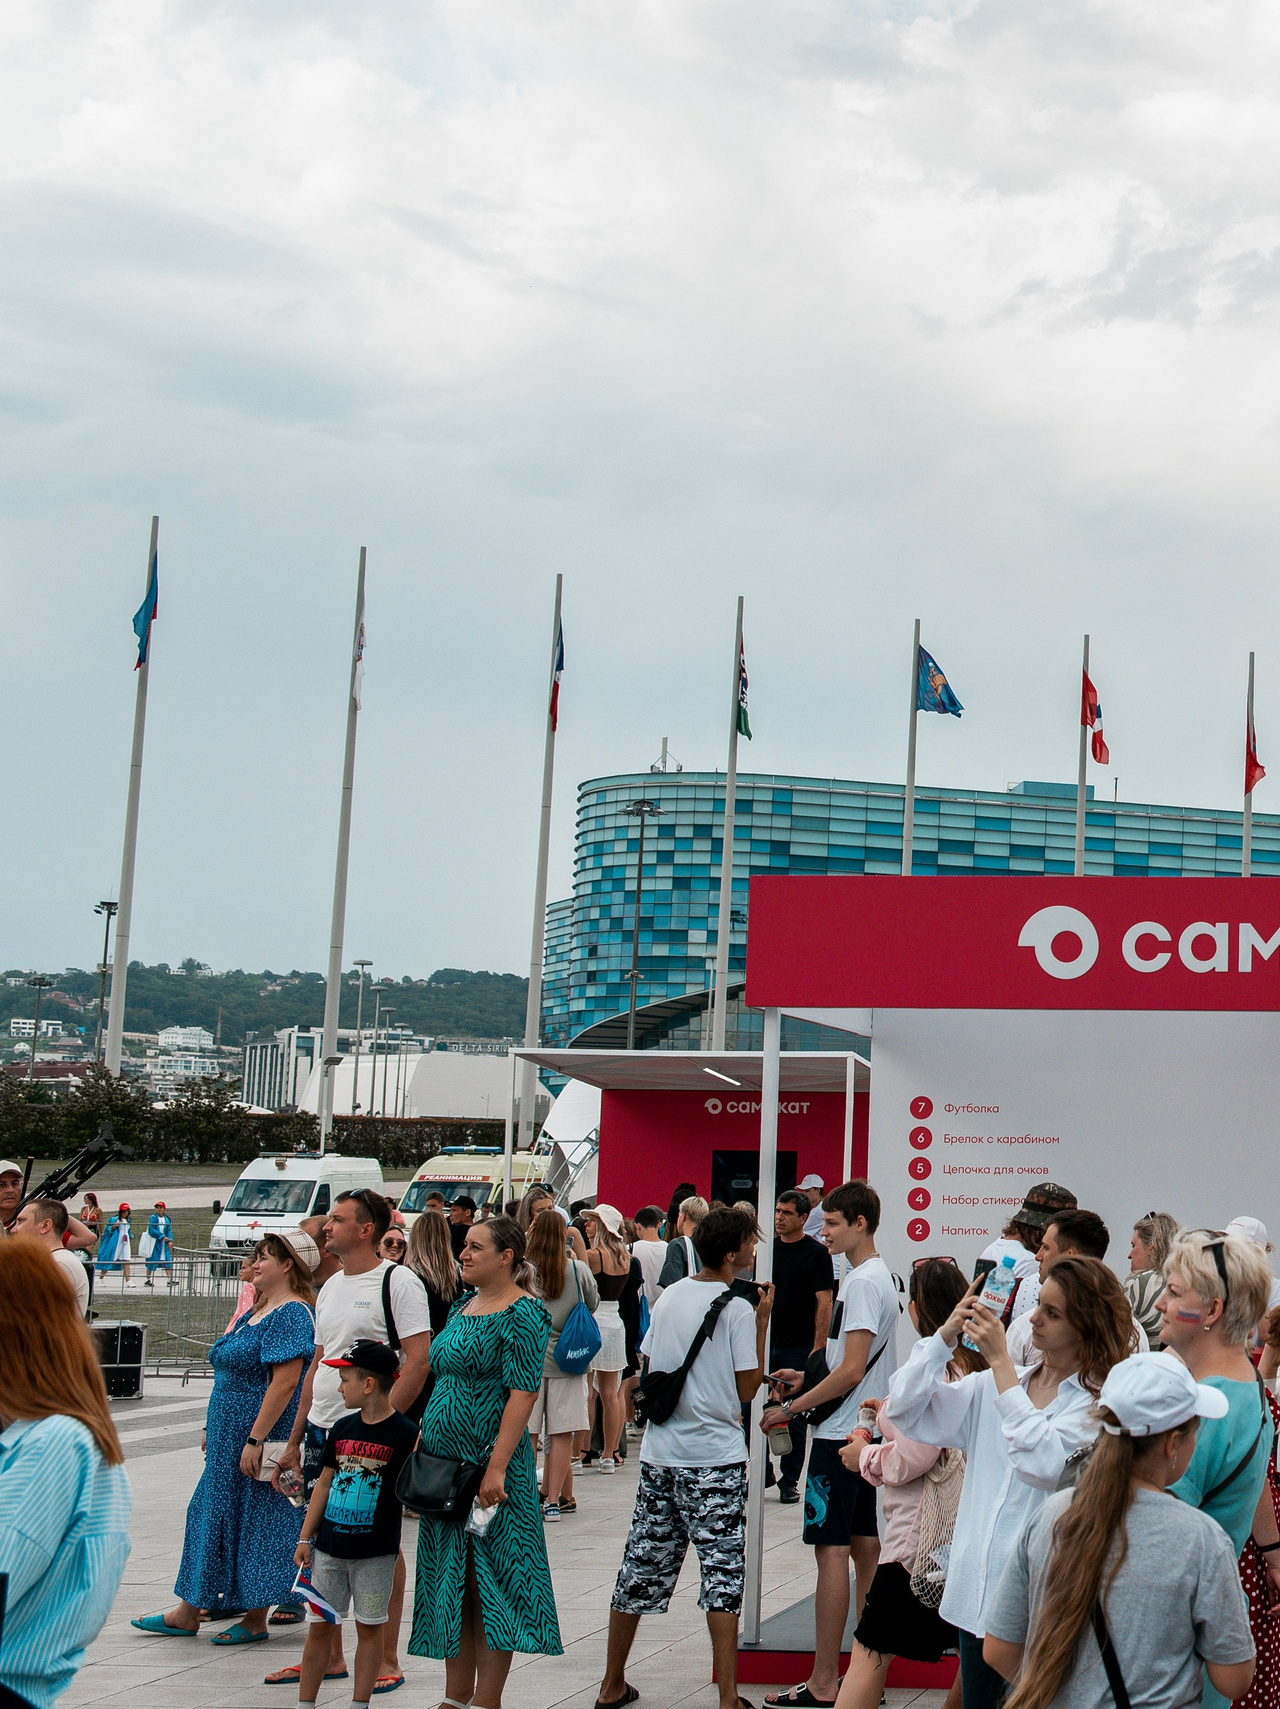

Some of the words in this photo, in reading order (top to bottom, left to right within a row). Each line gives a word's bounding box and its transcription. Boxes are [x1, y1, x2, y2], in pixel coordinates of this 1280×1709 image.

[452, 1044, 483, 1052] DELTA
[487, 1044, 510, 1053] SIRIU
[726, 1101, 811, 1114] самкат
[917, 1102, 926, 1113] 7
[944, 1103, 1000, 1116] Футболка
[917, 1133, 925, 1143] 6
[943, 1134, 984, 1146] Брелок
[987, 1136, 994, 1144] с
[997, 1134, 1060, 1146] карабином
[916, 1163, 924, 1174] 5
[943, 1164, 990, 1175] Цепочка
[993, 1166, 1014, 1175] для
[1017, 1166, 1049, 1175] очков
[915, 1194, 924, 1204] 4
[942, 1195, 979, 1207] Набор
[982, 1197, 1025, 1207] стикеро
[915, 1224, 923, 1235] 2
[941, 1225, 989, 1236] Напиток
